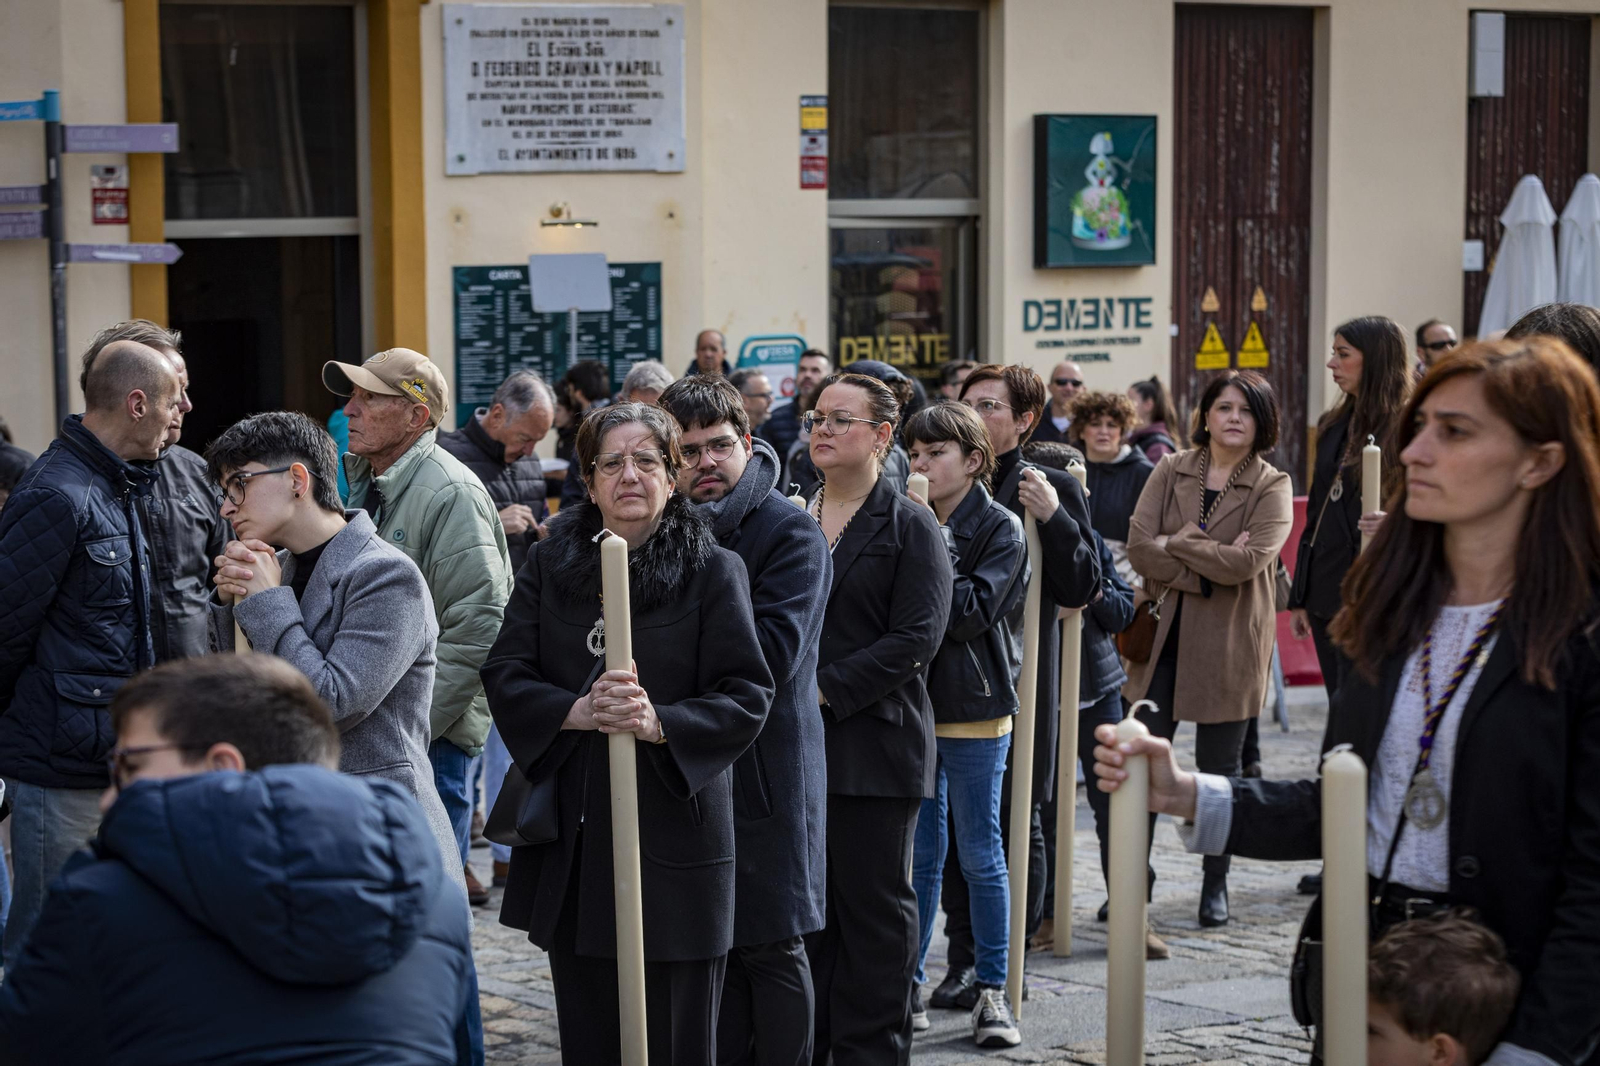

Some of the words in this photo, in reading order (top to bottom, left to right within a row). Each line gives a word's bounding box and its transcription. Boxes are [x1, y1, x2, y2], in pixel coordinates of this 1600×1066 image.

[485, 62, 540, 77] FEDERICO
[546, 62, 600, 77] GRAVINA
[515, 148, 592, 160] AYUNTAMIENTO
[488, 269, 523, 281] CARTA
[1023, 298, 1153, 333] DEMENTE
[840, 334, 949, 367] DEMENTE
